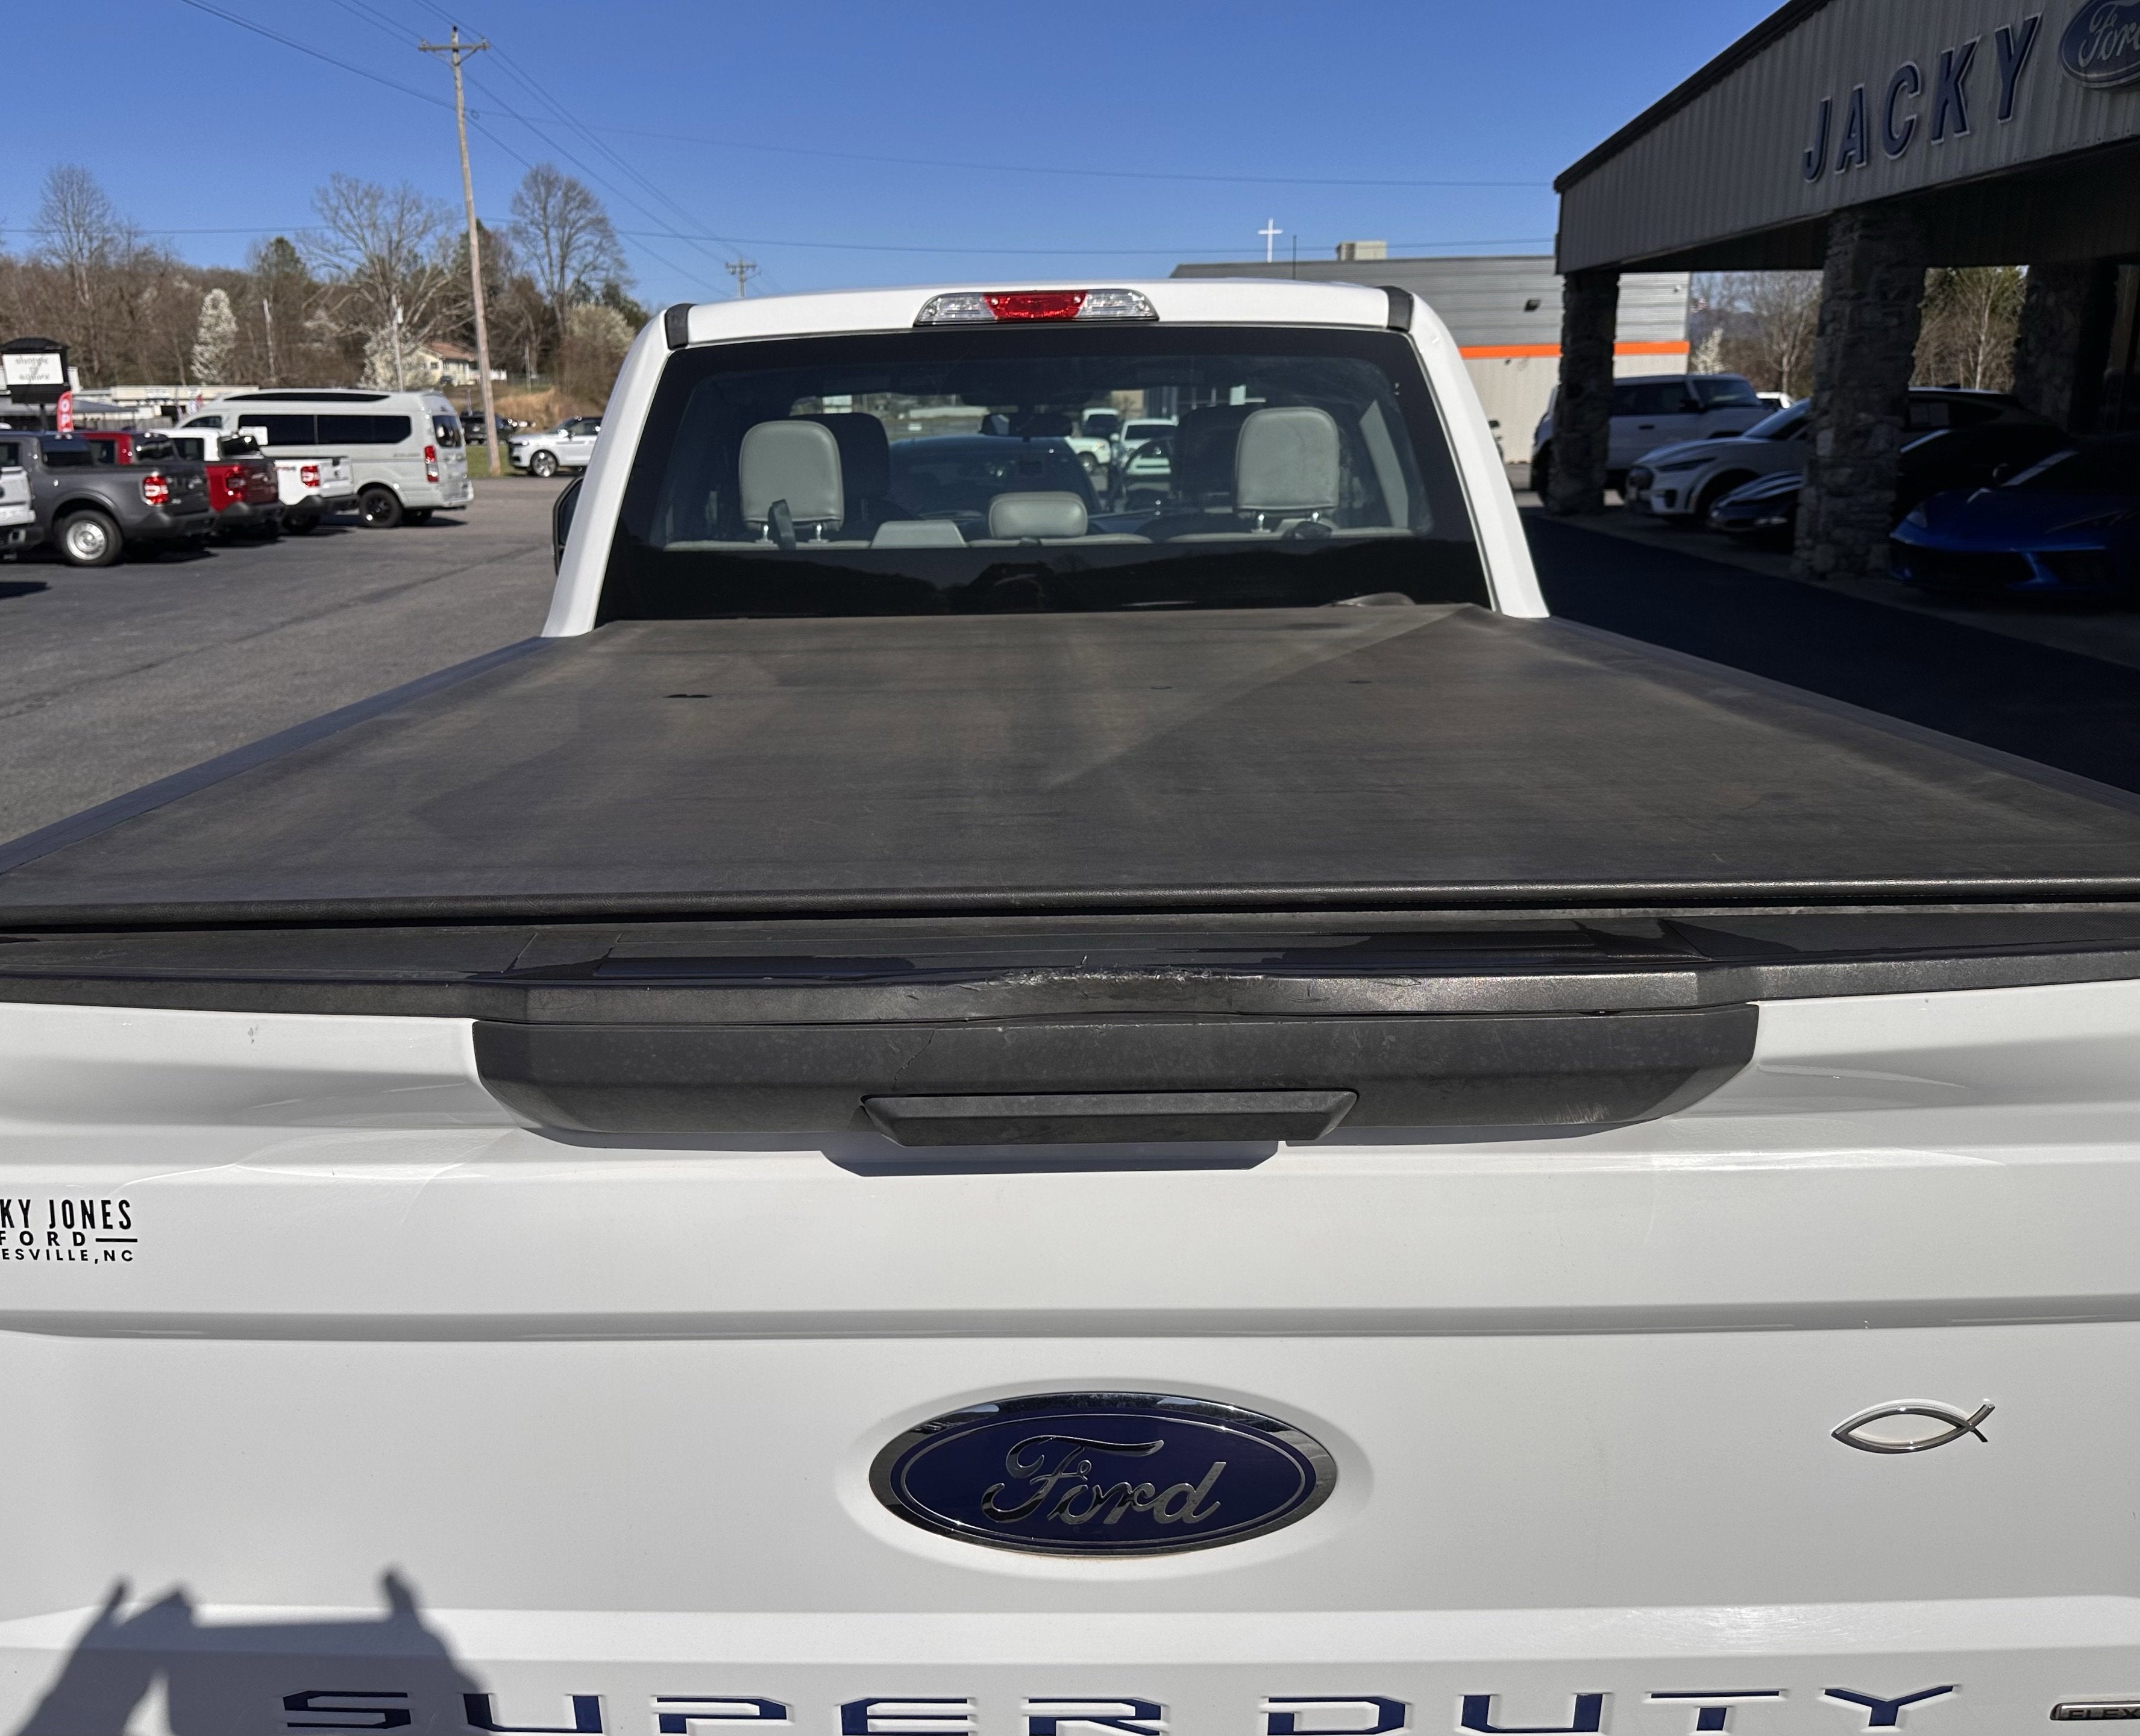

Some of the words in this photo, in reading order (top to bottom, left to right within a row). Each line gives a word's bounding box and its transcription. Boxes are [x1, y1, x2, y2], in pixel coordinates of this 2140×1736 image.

[1803, 11, 2042, 184] JACKY
[49, 1199, 131, 1230] JONES
[981, 1435, 1227, 1525] Ford
[282, 1690, 1163, 1736] SUPER
[1266, 1685, 1954, 1736] DUTY
